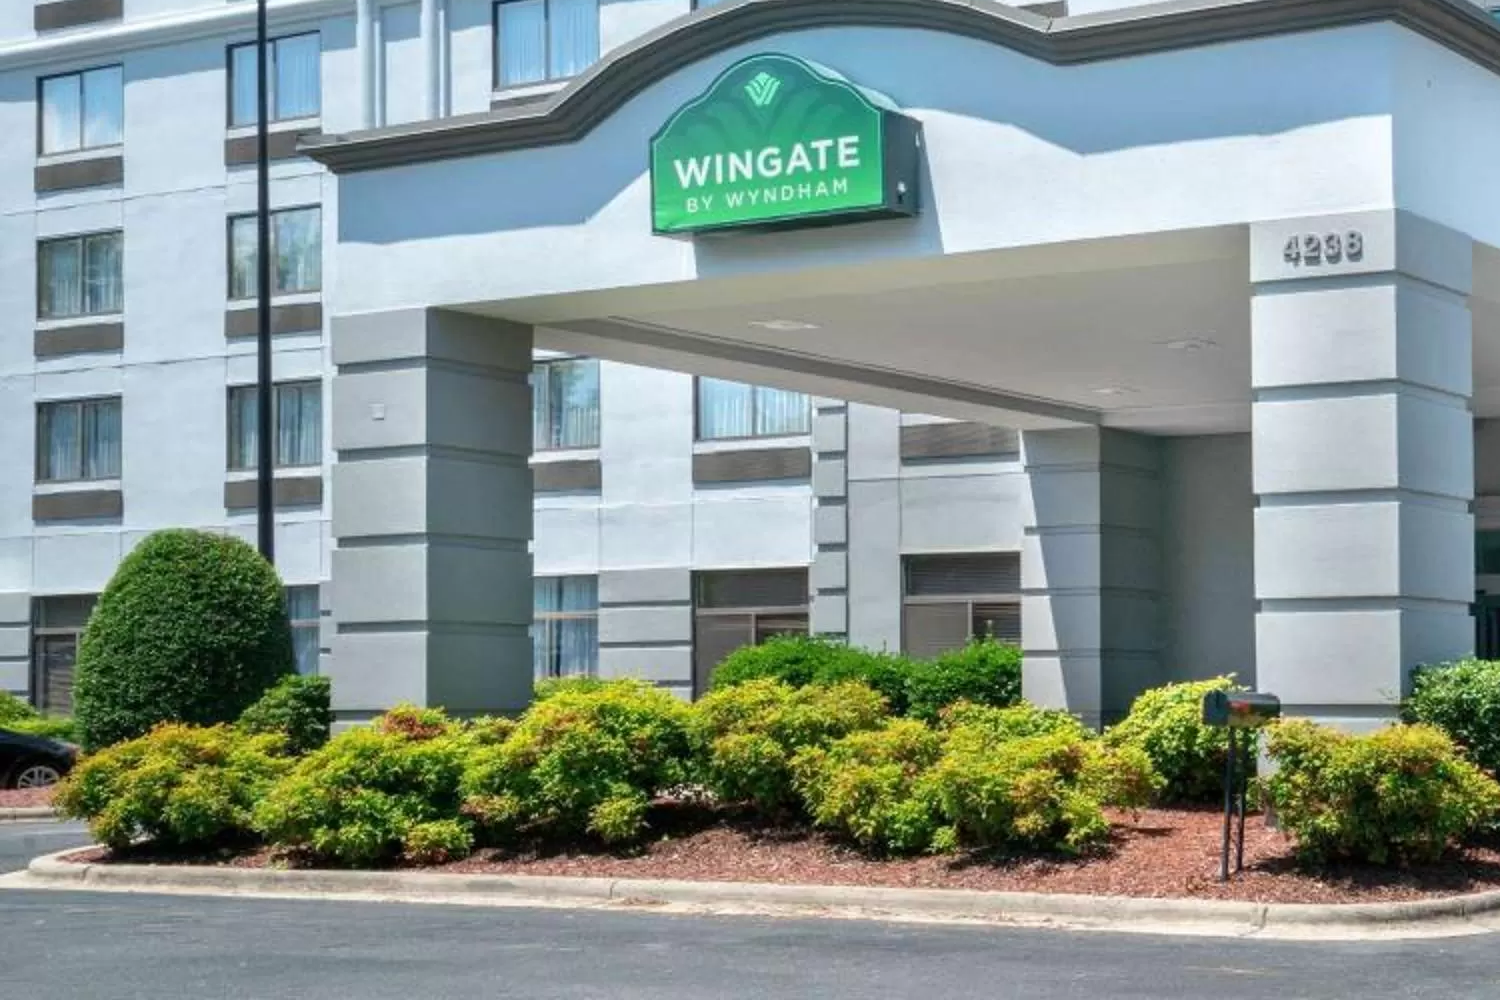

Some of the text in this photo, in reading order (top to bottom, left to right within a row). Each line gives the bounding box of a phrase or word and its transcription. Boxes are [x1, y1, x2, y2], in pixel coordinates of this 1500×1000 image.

[673, 135, 861, 190] WINGATE
[686, 177, 849, 214] BY WYNDHAM
[1283, 230, 1363, 267] 4238
